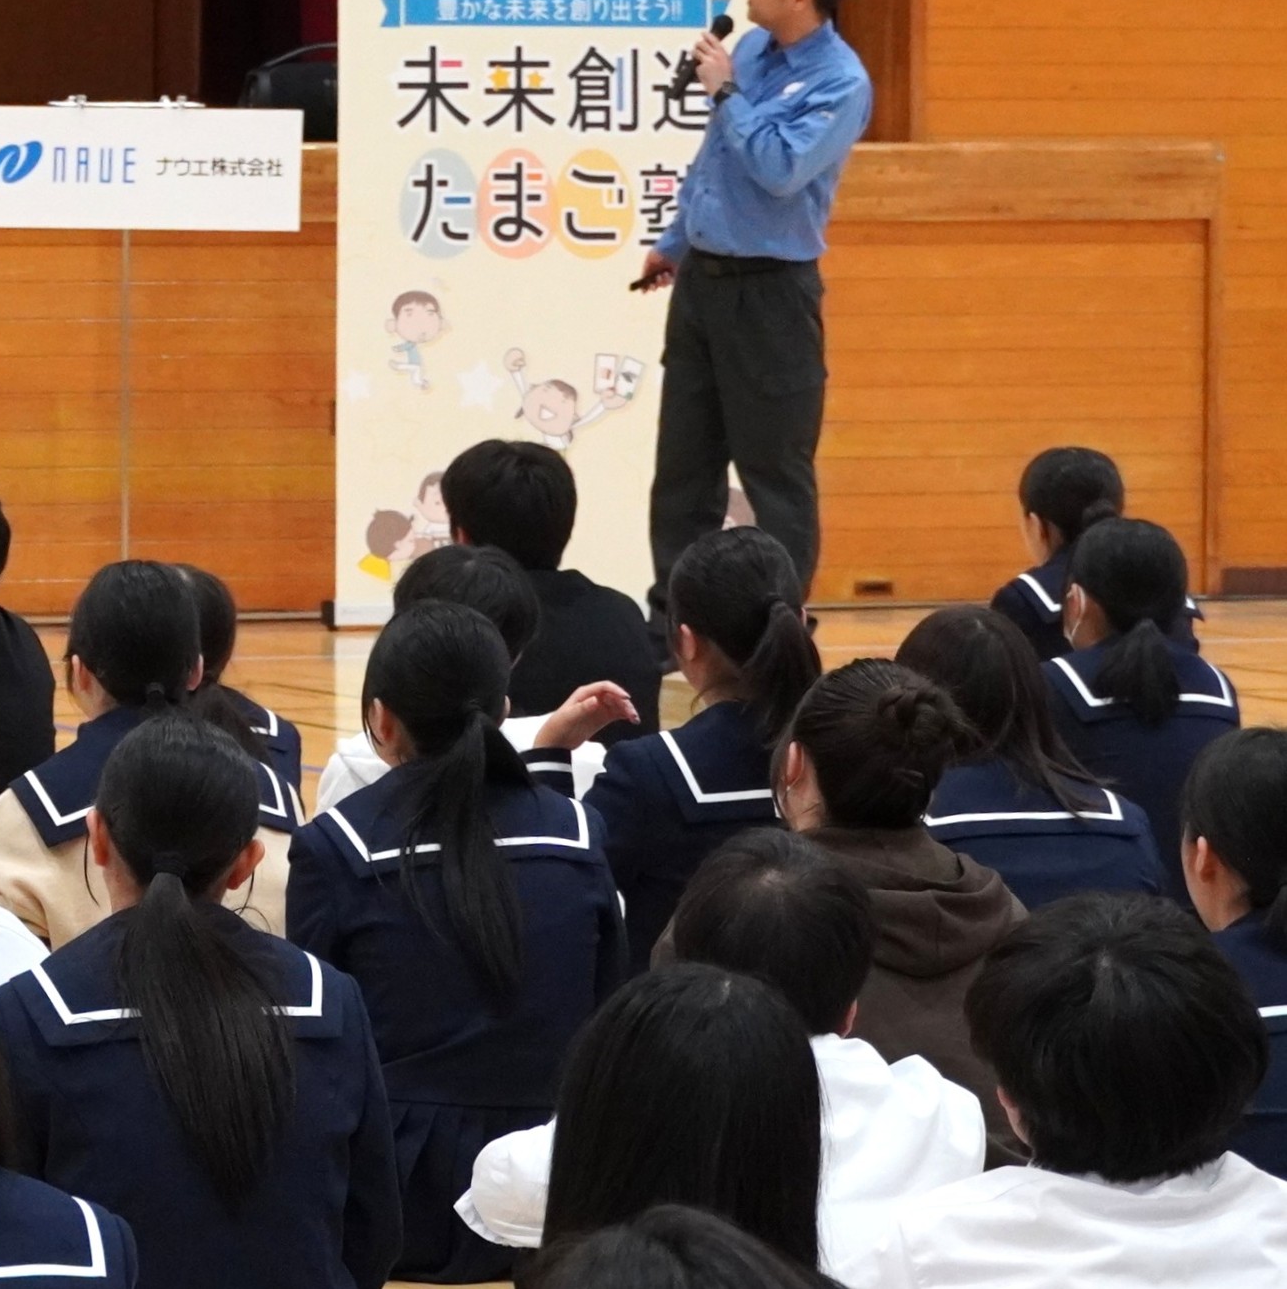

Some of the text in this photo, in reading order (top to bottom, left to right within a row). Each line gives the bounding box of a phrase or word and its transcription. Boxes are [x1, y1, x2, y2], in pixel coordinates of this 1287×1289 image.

[156, 157, 283, 177] ナウエ株式会社
